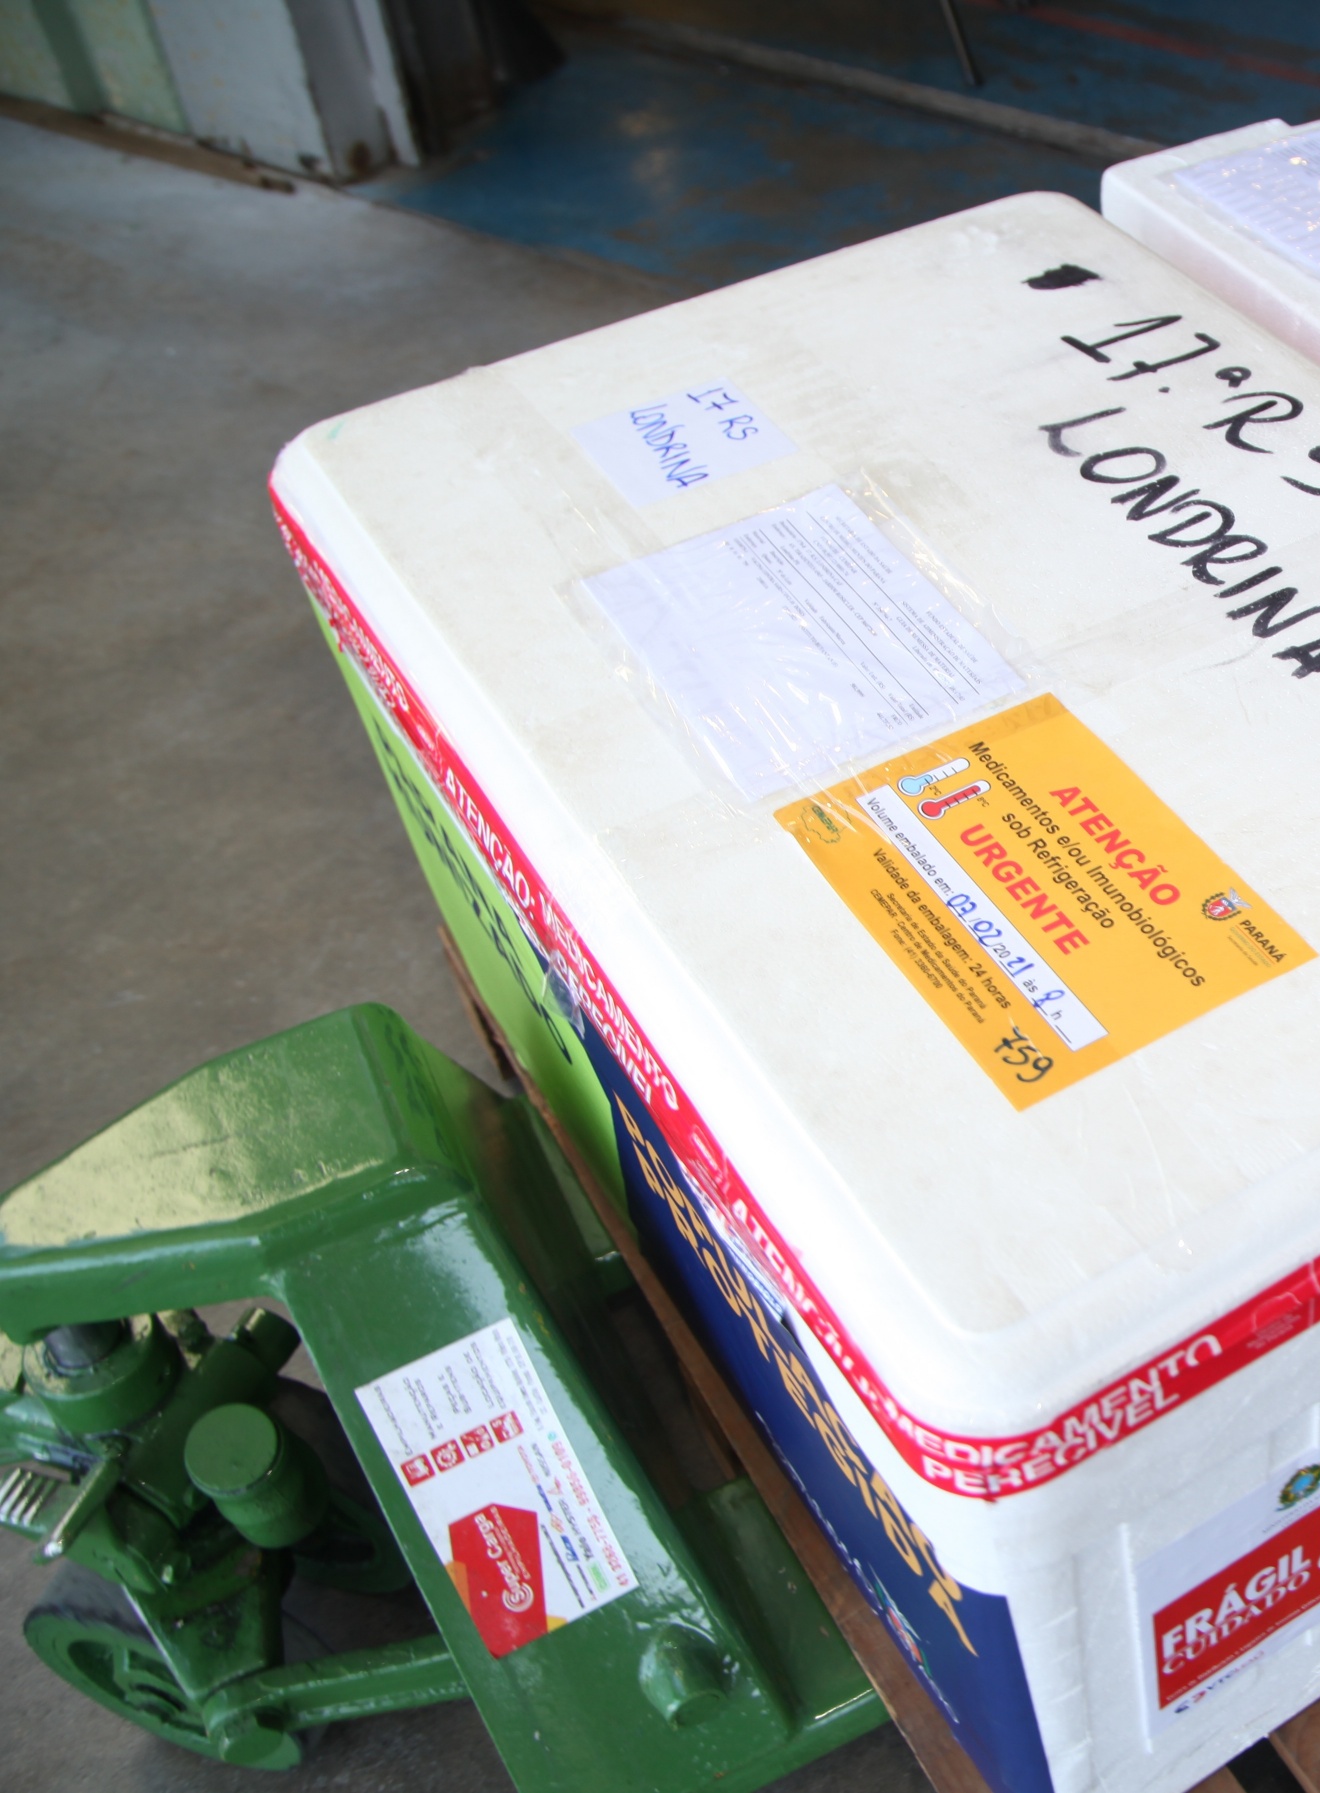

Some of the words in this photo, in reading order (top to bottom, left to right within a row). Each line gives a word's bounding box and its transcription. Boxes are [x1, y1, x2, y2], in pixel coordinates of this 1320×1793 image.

[628, 403, 711, 490] LONDRINA
[686, 386, 740, 413] 17
[717, 413, 761, 443] RS
[444, 768, 536, 921] ATENÇÃO:
[960, 823, 1089, 955] URGENTE
[968, 740, 1060, 835] Medicamentos
[1056, 835, 1091, 867] e/ou
[1086, 865, 1205, 987] Imunobiológicos
[1001, 812, 1032, 839] sob
[1026, 837, 1115, 929] Refrigeração
[1049, 786, 1181, 906] ATENÇÃO
[866, 796, 898, 832] Volume
[894, 831, 937, 877] embalado
[930, 874, 960, 898] em:
[1019, 975, 1045, 996] às
[1047, 1007, 1067, 1022] h
[869, 888, 898, 919] CEMEPAR
[896, 920, 916, 942] Centro
[910, 939, 926, 952] de
[919, 948, 958, 993] Medicamentos
[953, 990, 970, 1004] do
[963, 999, 985, 1024] Paraná
[872, 847, 910, 890] Validade
[902, 887, 927, 906] da
[917, 903, 973, 964] embalagem:
[967, 962, 988, 978] 24
[980, 976, 1012, 1009] horas
[885, 892, 913, 923] Secretaria
[907, 919, 923, 932] de
[916, 928, 937, 951] Estado
[931, 948, 948, 961] da
[940, 957, 962, 980] Saúde
[956, 977, 972, 989] do
[965, 985, 987, 1010] Paraná
[887, 927, 910, 949] Fone:
[1238, 918, 1286, 963] PARANÁ
[993, 1025, 1054, 1083] 759
[631, 1137, 980, 1658] PROTEGIDA
[921, 1391, 1180, 1495] PERECÍVEL
[473, 1512, 503, 1559] Carga
[490, 1555, 530, 1606] Super
[1161, 1546, 1311, 1662] FRÁGIL
[1162, 1562, 1311, 1675] CUIDADO
